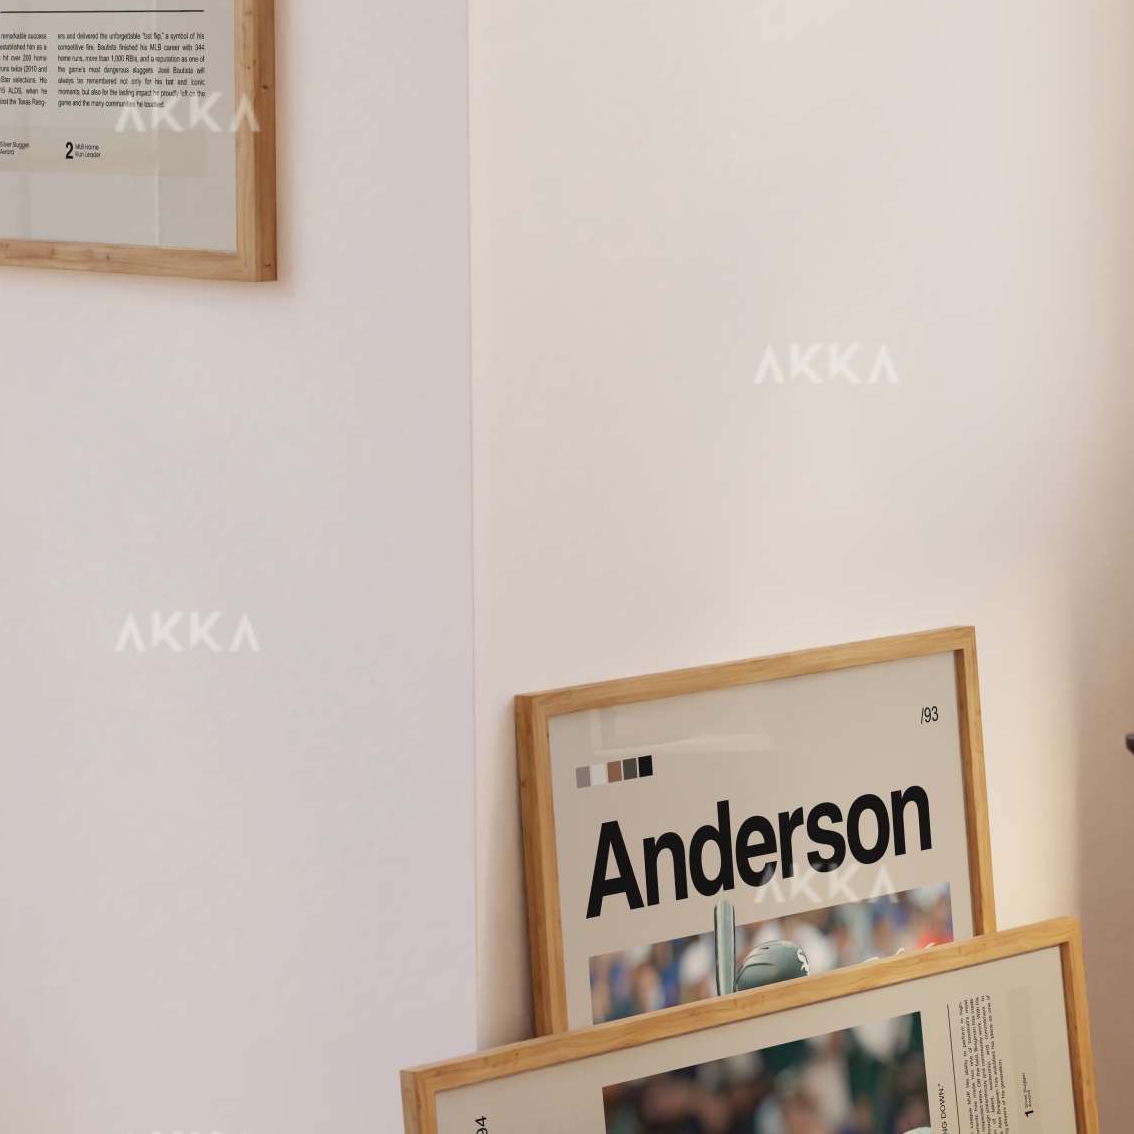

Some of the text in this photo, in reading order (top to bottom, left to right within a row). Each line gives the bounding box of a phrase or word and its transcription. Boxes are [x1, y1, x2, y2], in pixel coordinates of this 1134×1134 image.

[65, 141, 74, 159] 2
[920, 706, 939, 725] /93
[586, 785, 932, 919] Anderson
